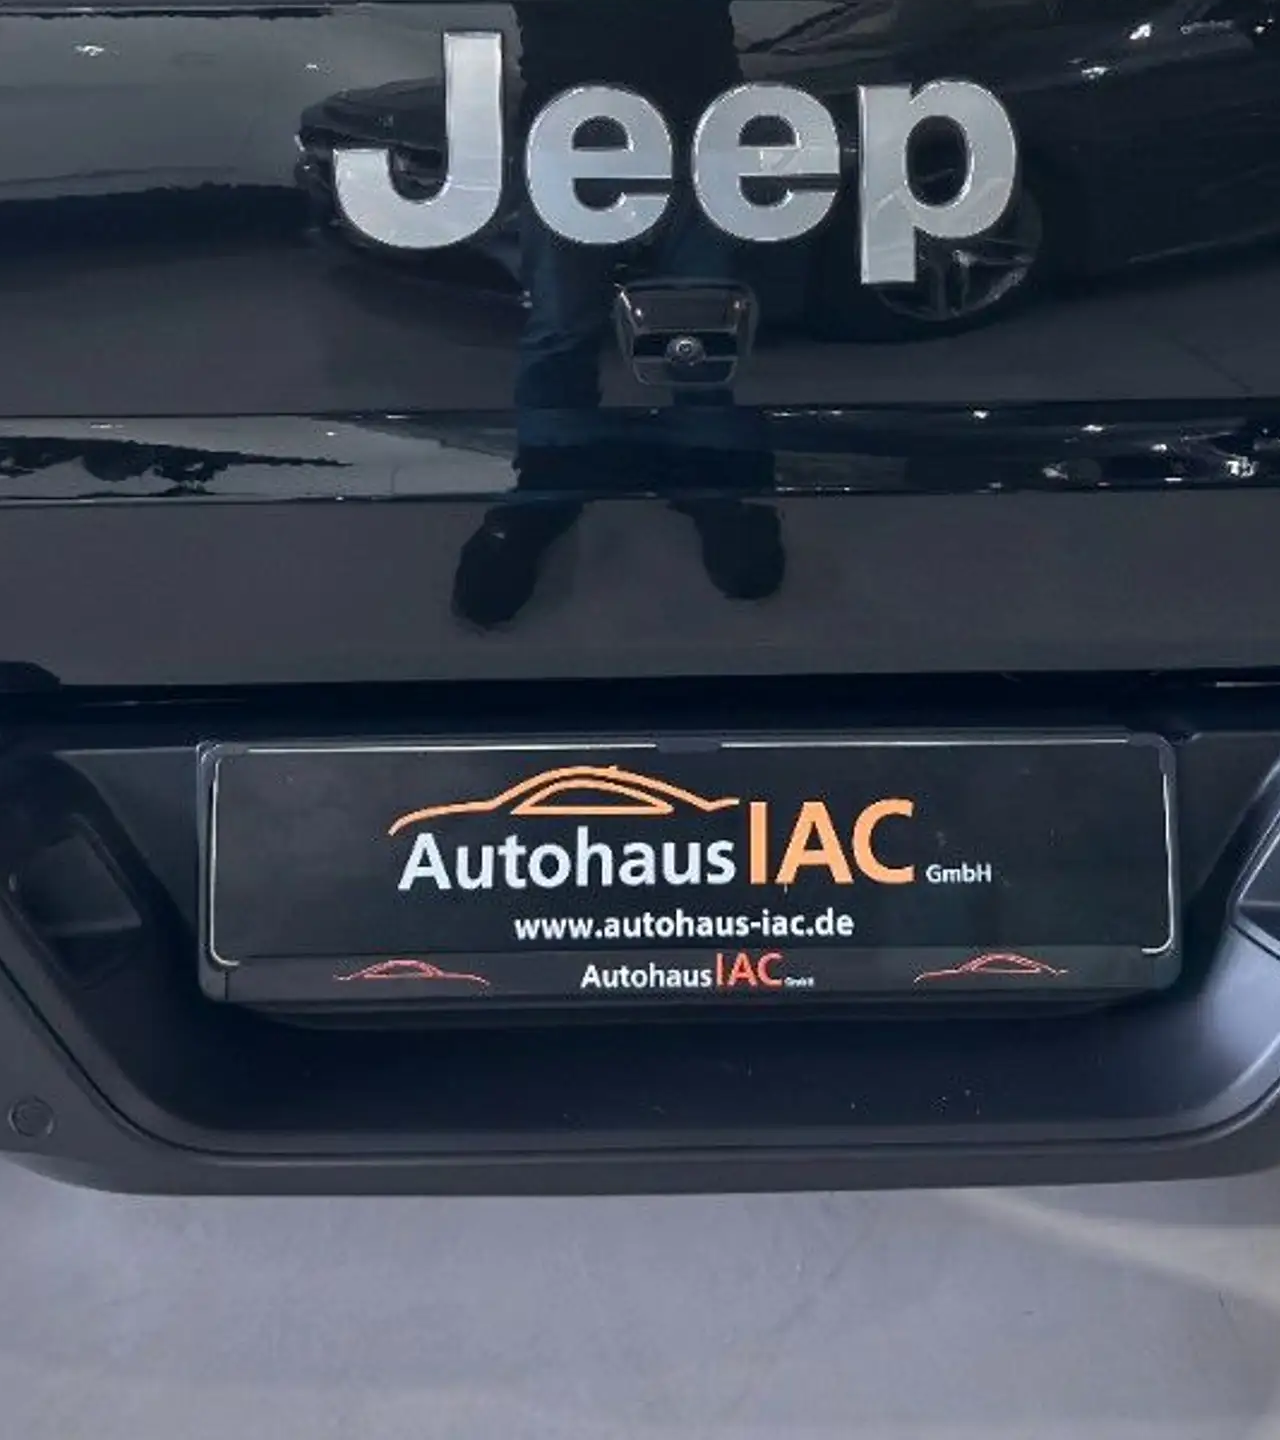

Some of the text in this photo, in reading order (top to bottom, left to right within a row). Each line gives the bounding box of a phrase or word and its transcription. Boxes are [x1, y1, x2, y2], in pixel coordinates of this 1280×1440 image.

[332, 31, 1017, 284] Jeep
[397, 798, 993, 891] Autohaus IAC GmbH
[513, 906, 855, 940] www.autohaus-iac.de
[580, 961, 713, 989] Autohaus
[715, 952, 783, 987] IAC
